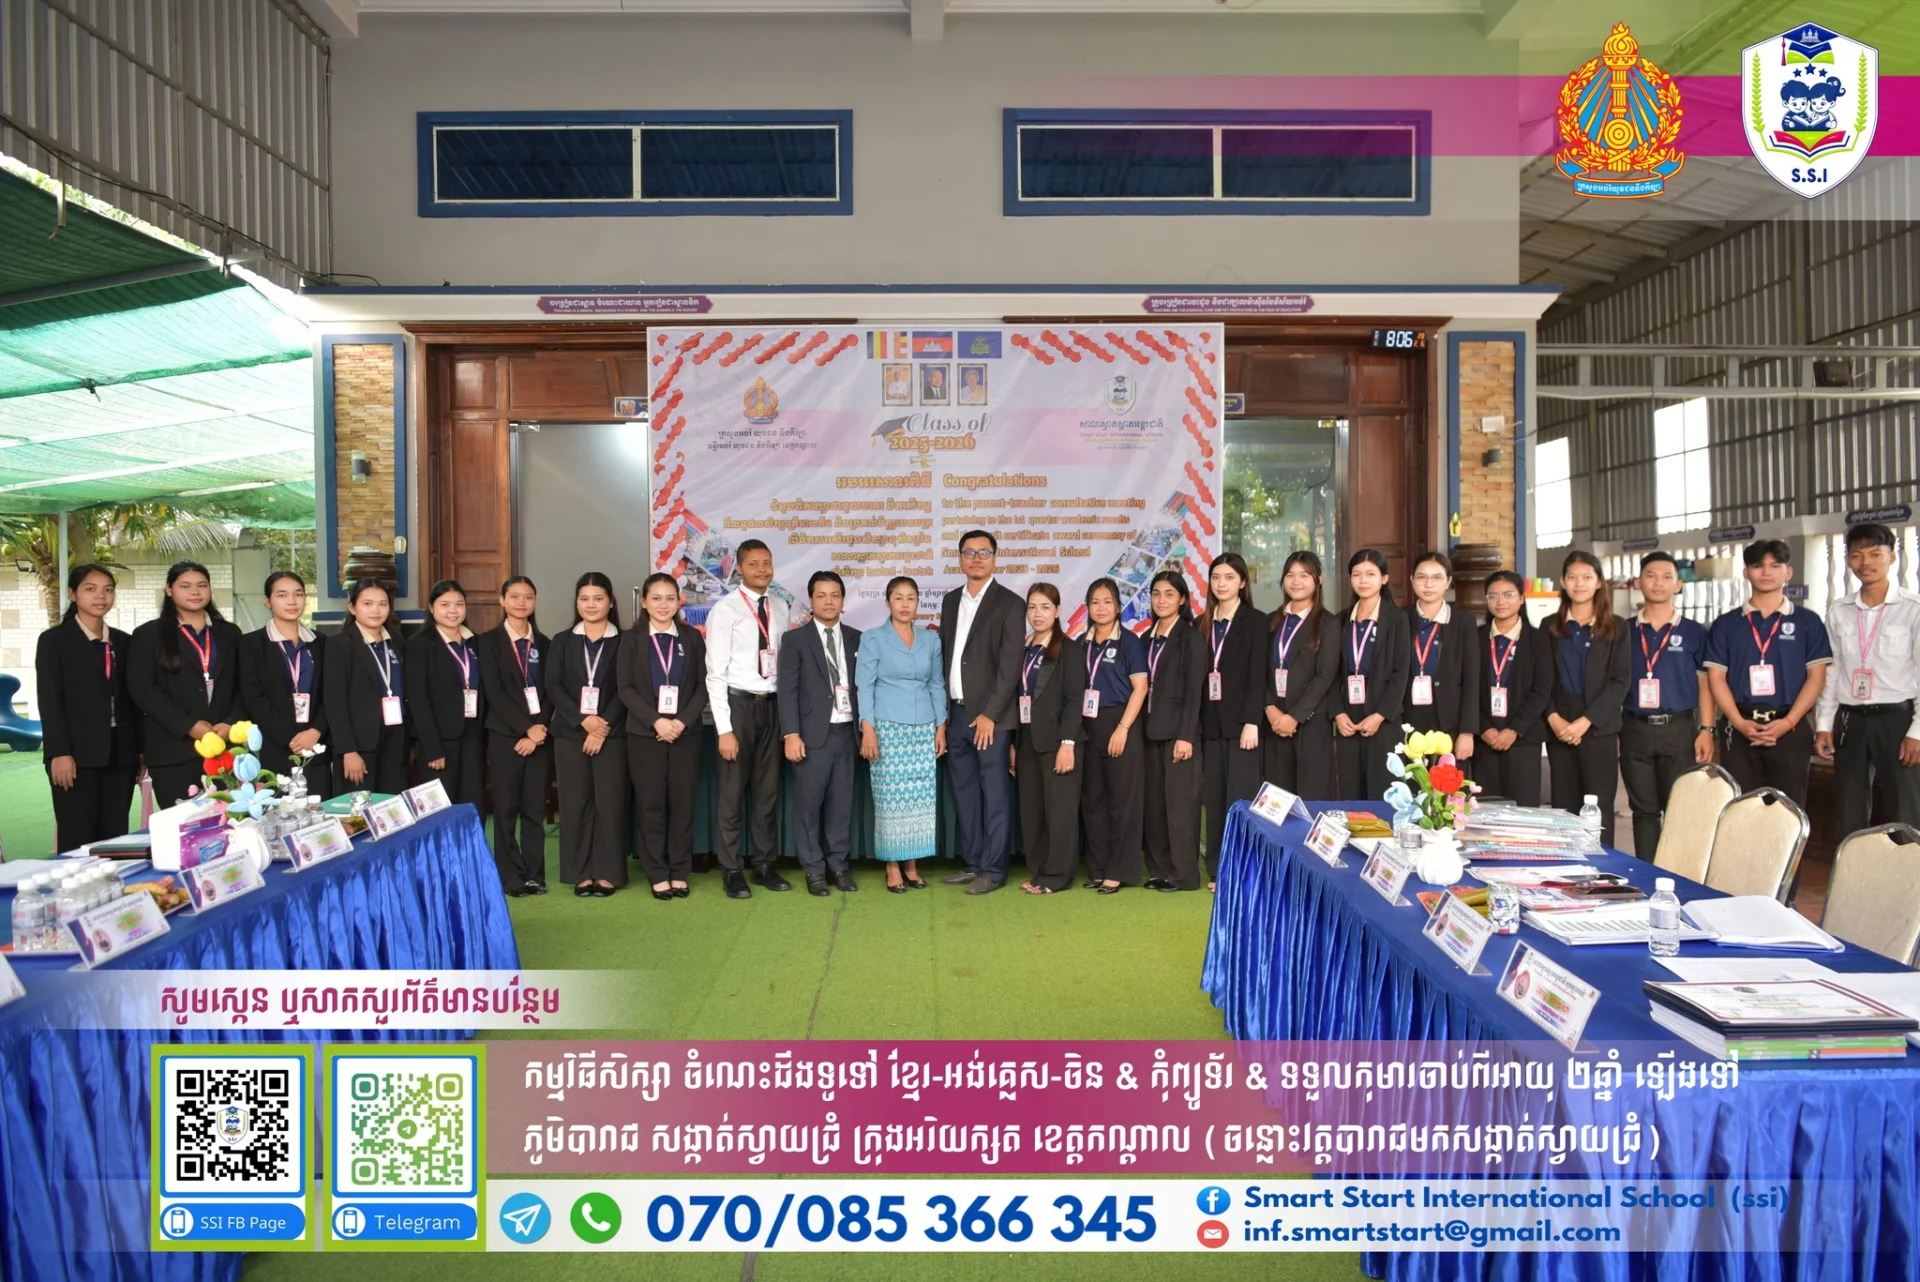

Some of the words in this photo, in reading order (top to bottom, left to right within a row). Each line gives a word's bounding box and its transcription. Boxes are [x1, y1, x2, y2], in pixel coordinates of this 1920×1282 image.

[907, 412, 963, 434] Class
[968, 412, 990, 435] of
[889, 432, 977, 454] 2025-2026
[943, 472, 1047, 490] Congratulations
[942, 498, 953, 508] to
[954, 497, 971, 508] the
[973, 496, 1047, 510] parent-teacher
[1049, 497, 1106, 508] consultative
[1107, 497, 1146, 510] meeting
[942, 515, 985, 526] pertaining
[987, 515, 996, 524] to
[998, 514, 1012, 524] the
[1028, 515, 1059, 526] quarter
[1061, 514, 1100, 524] academic
[1101, 514, 1130, 524] results
[941, 530, 958, 540] and
[1003, 530, 1050, 540] certificate
[1053, 530, 1080, 540] award
[1081, 531, 1126, 542] ceremony
[1126, 529, 1138, 540] of
[1059, 546, 1091, 557] School
[1006, 564, 1028, 574] 2025
[1036, 564, 1060, 574] 2026
